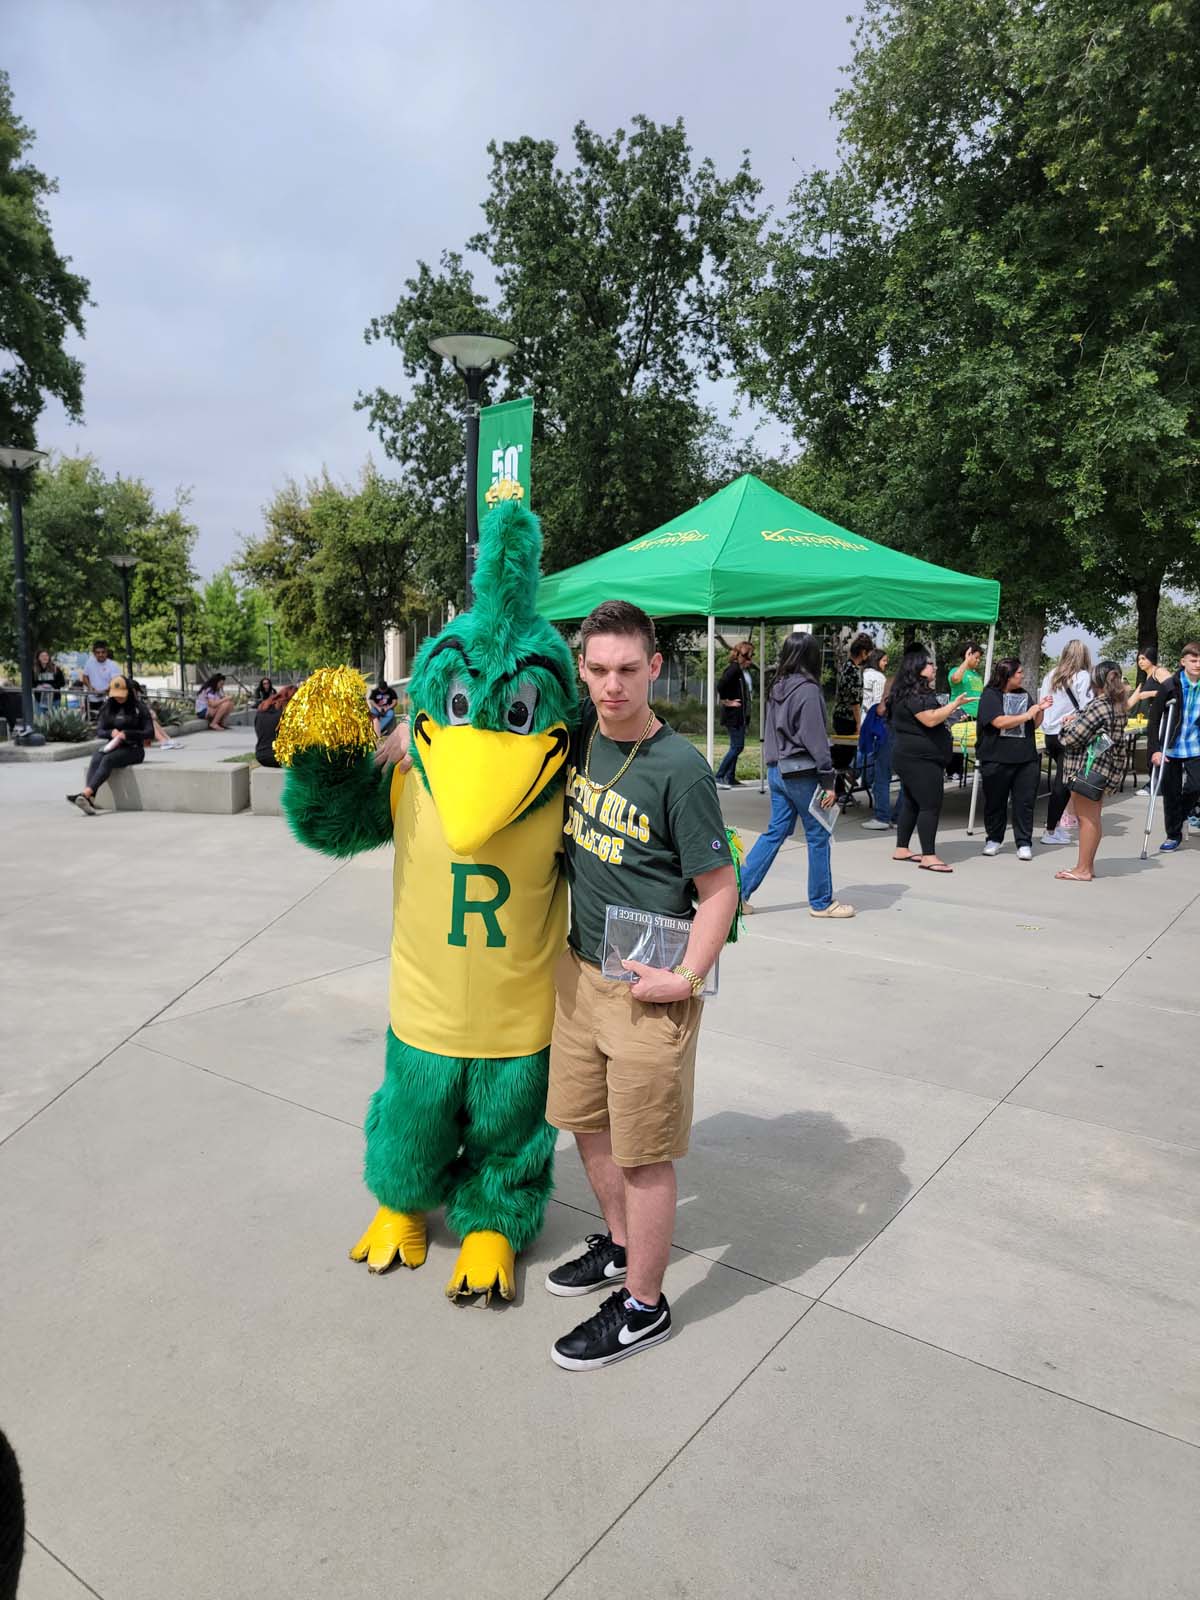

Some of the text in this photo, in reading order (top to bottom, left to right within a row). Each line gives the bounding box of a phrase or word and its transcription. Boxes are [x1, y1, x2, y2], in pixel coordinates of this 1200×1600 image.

[599, 788, 650, 844] HILLS
[447, 862, 511, 948] R
[618, 909, 692, 931] ON HILLS COLLEGE
